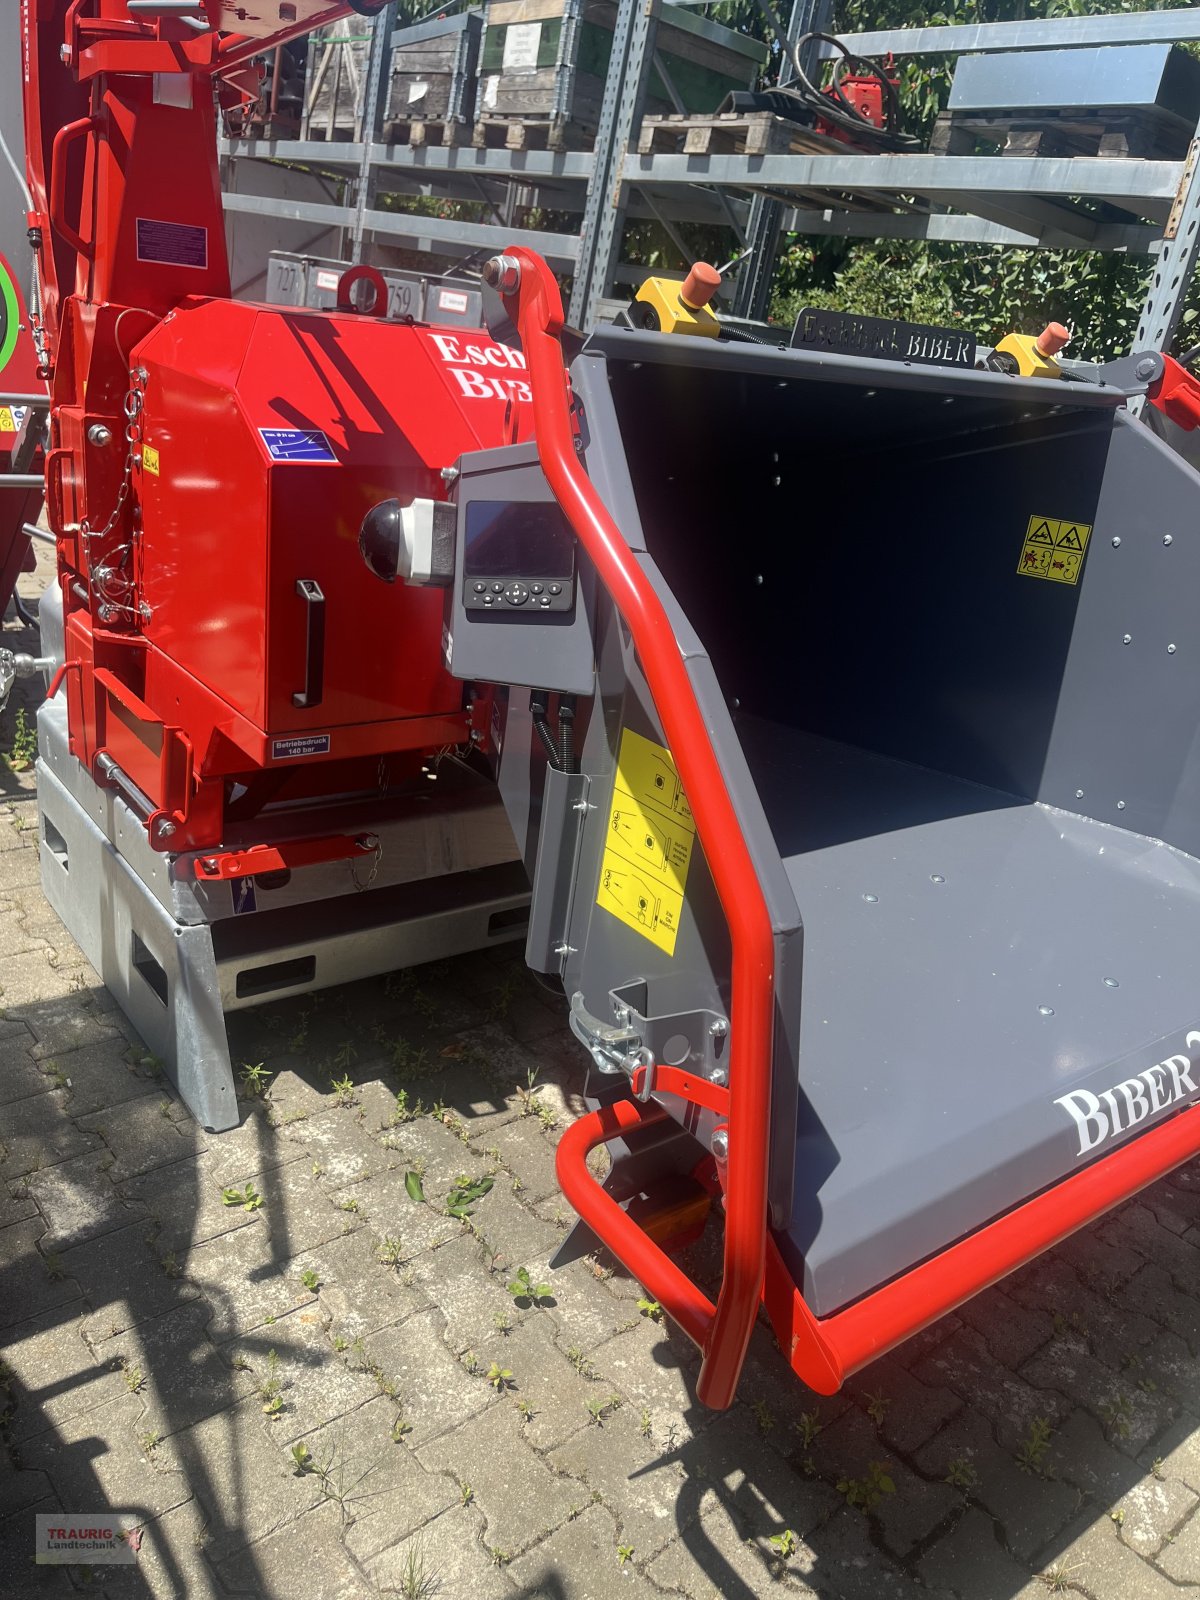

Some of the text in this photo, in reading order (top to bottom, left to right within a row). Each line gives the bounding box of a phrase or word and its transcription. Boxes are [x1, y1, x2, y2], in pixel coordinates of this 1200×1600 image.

[906, 330, 971, 363] BIBER
[276, 737, 327, 749] Betriebsdruck
[288, 747, 302, 755] 140
[1053, 1054, 1199, 1157] BIBER
